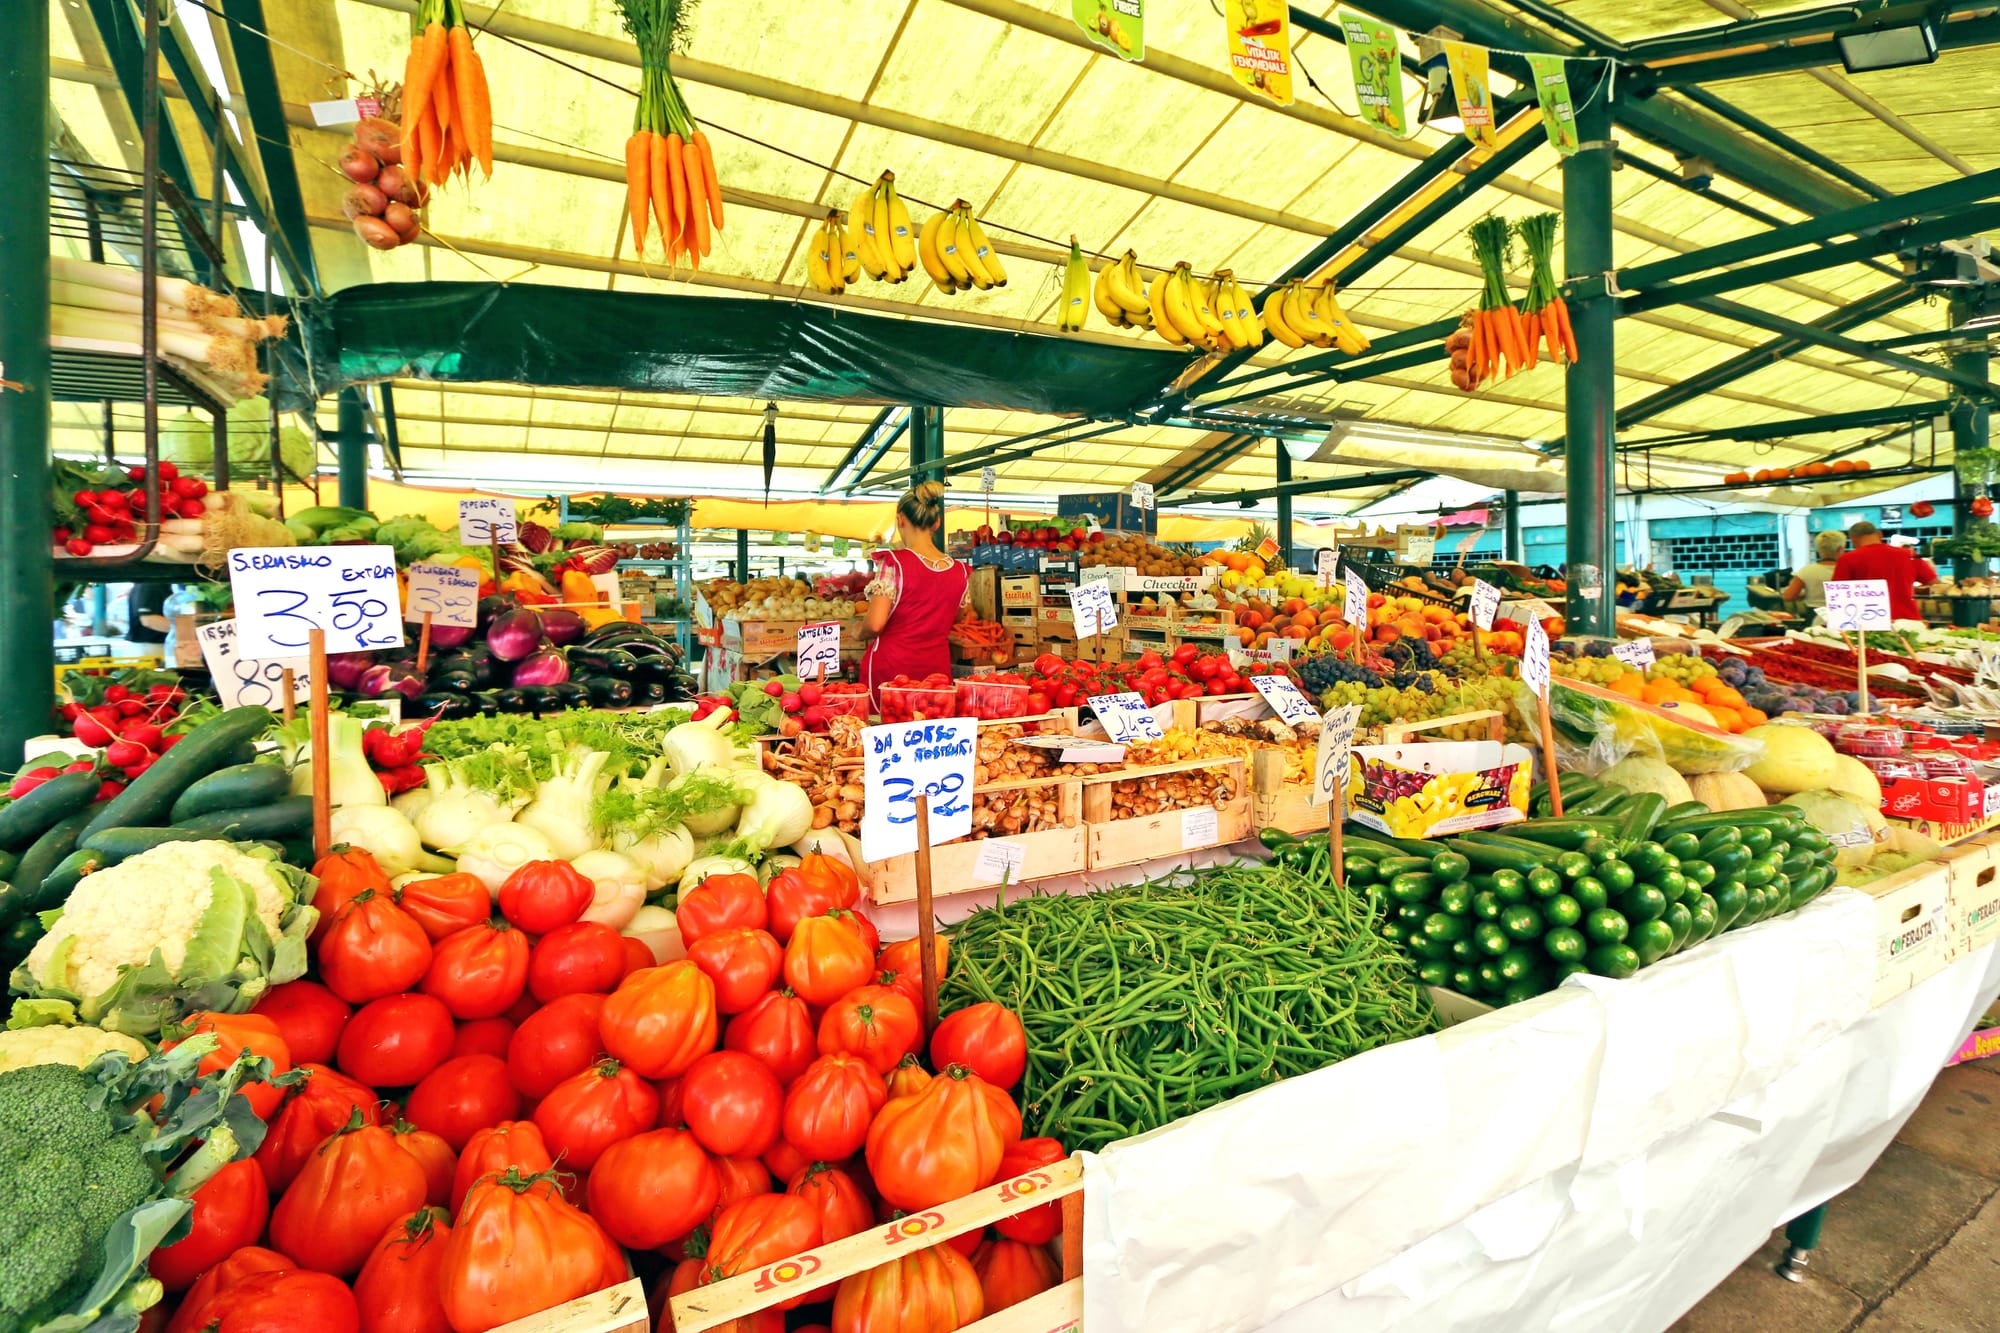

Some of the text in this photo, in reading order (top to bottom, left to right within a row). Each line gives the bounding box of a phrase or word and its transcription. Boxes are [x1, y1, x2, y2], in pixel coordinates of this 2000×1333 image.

[1113, 1, 1140, 17] FIBRE
[1233, 54, 1288, 74] FENOMENALE
[341, 565, 395, 581] EXTRA
[1890, 919, 1933, 956] COFERASTA
[997, 1172, 1053, 1203] COF
[884, 1212, 945, 1246] COF
[754, 1255, 822, 1293] COF
